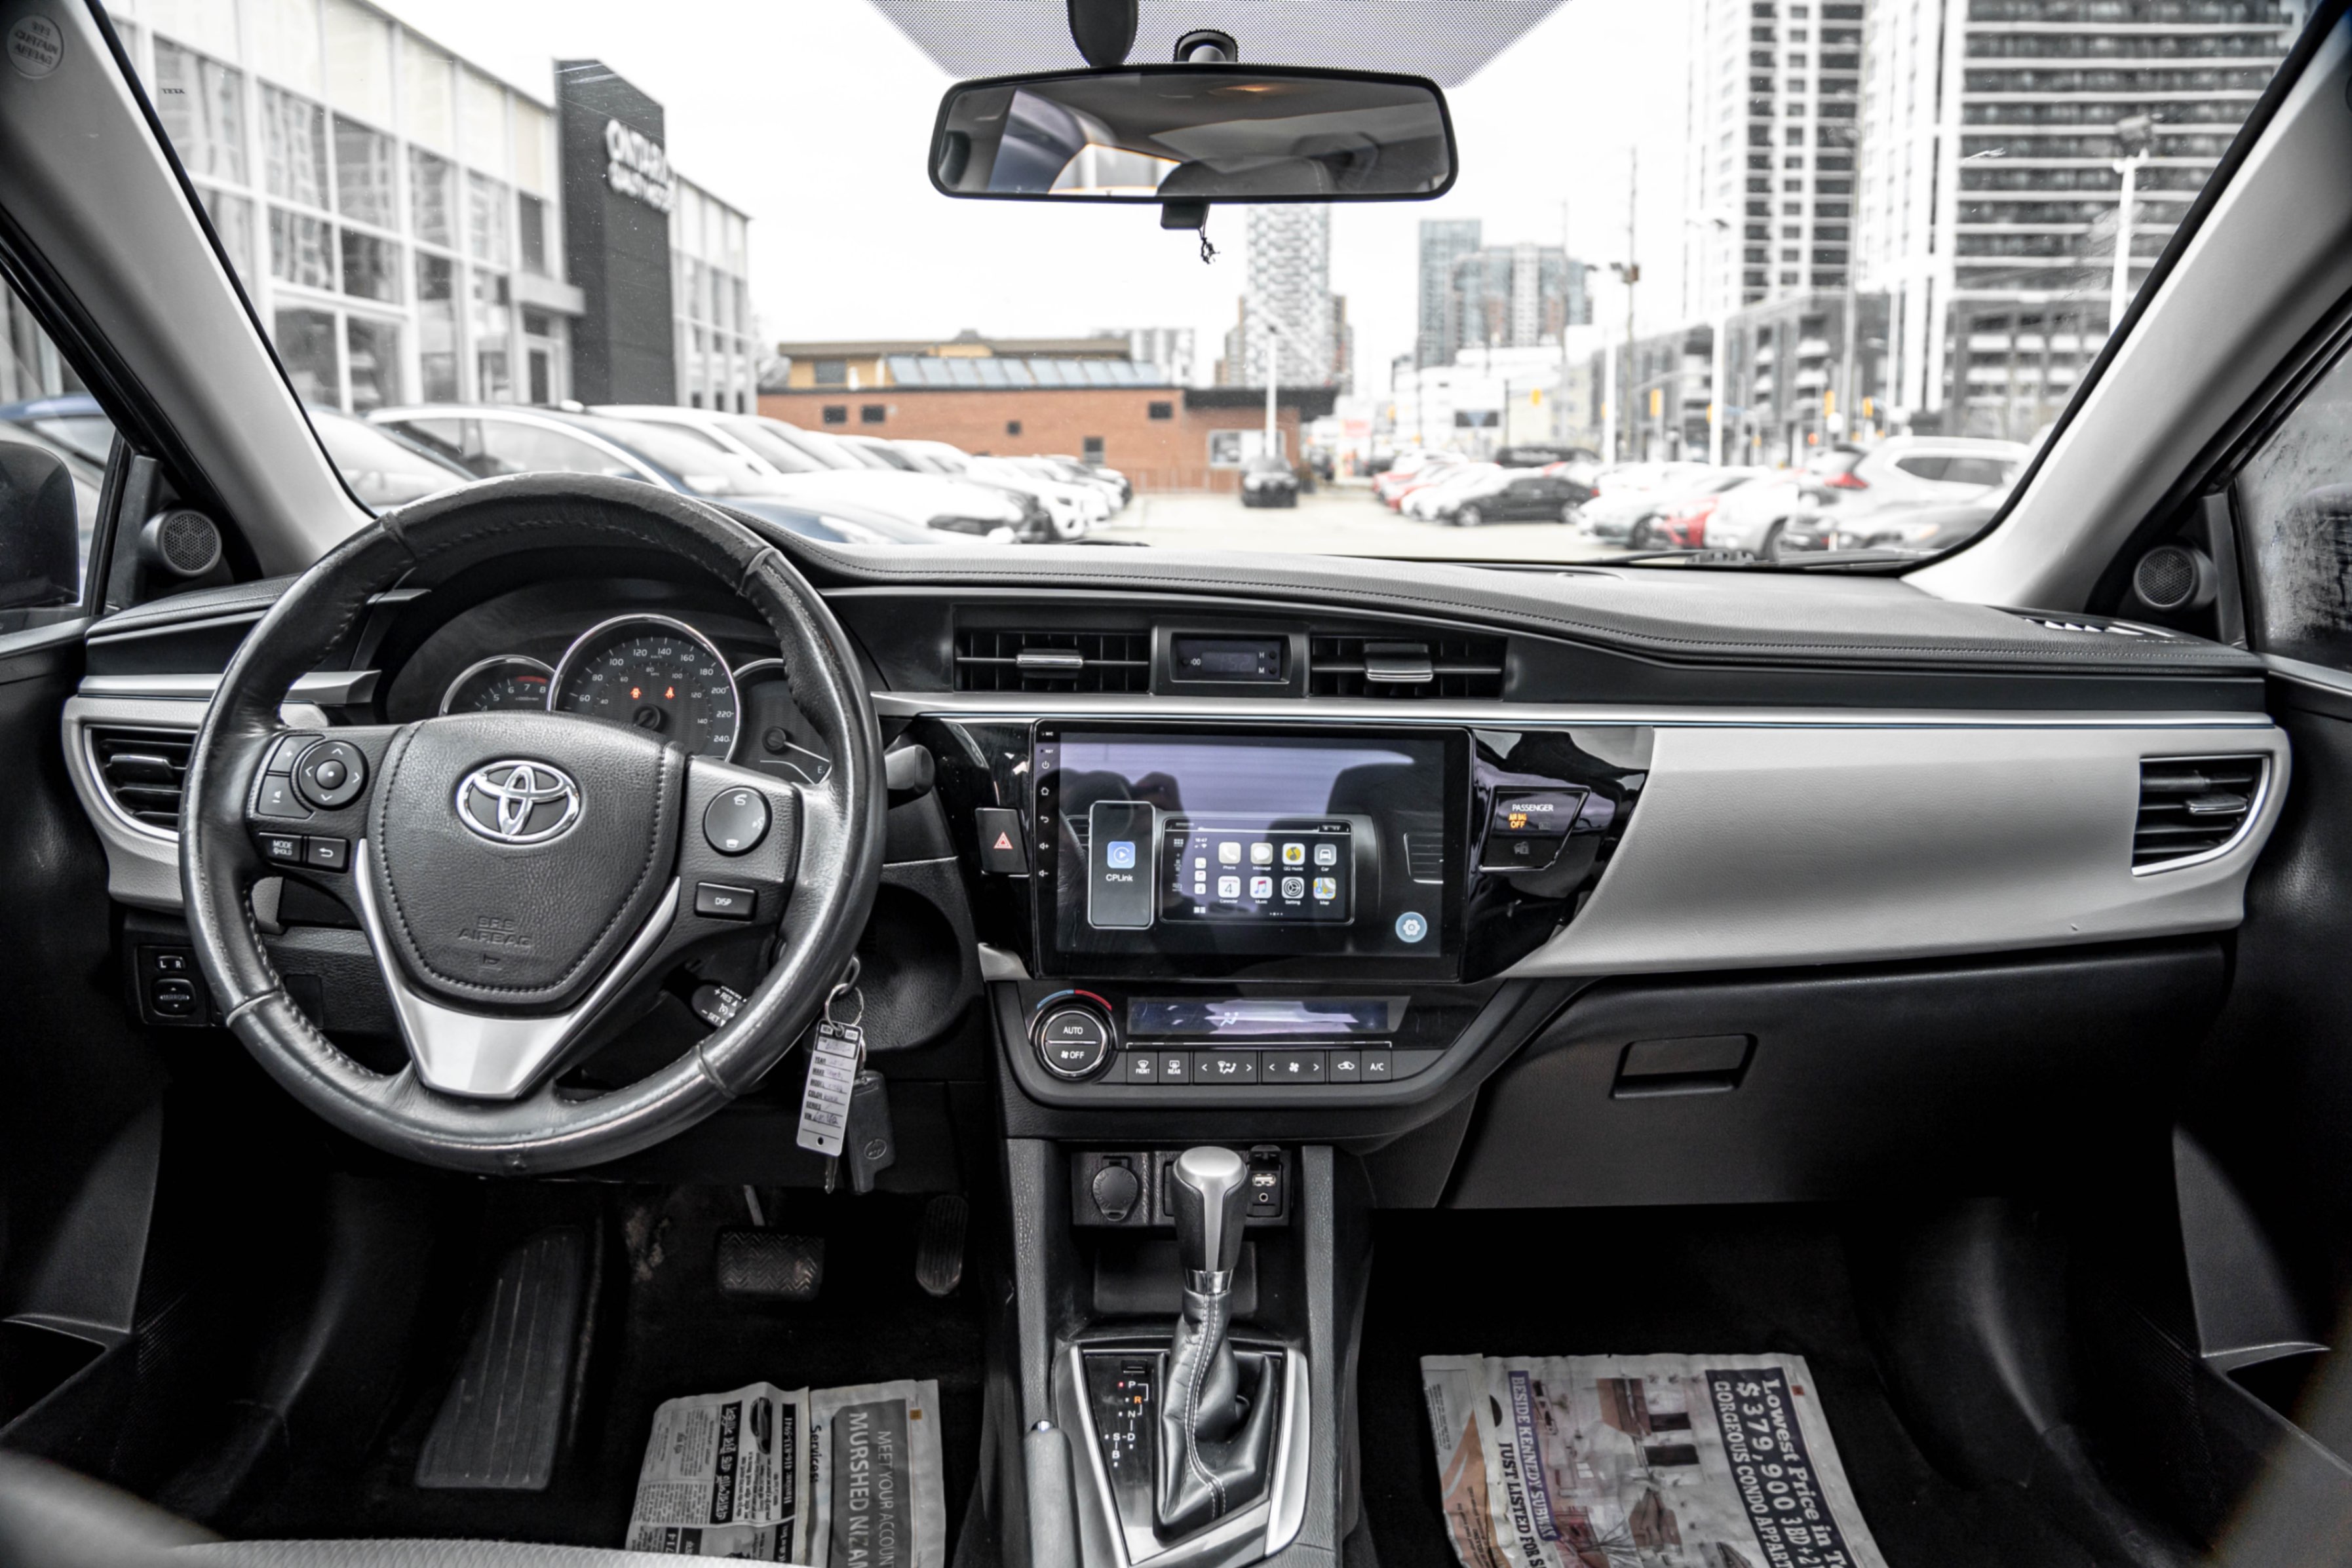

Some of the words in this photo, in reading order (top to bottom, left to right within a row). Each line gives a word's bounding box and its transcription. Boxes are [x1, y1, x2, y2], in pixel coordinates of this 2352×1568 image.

[817, 765, 823, 774] E
[1510, 820, 1526, 829] OFF
[273, 840, 292, 849] MODE
[1106, 873, 1133, 882] CPLink
[1224, 883, 1233, 894] 4
[715, 897, 732, 906] DISP
[478, 916, 515, 930] SRS
[458, 928, 532, 948] AIRBAG
[720, 991, 733, 1003] RES
[708, 1012, 720, 1023] SET
[1063, 1026, 1083, 1035] AUTO
[1370, 1062, 1384, 1071] A/C
[807, 1089, 822, 1100] COLOR
[1511, 1376, 1530, 1423] BESIDE
[1113, 1432, 1121, 1441] S
[1127, 1432, 1135, 1442] D
[877, 1430, 893, 1468] MEET
[1714, 1381, 1751, 1463] GORGEOUS
[1737, 1465, 1769, 1514] CONDO
[1111, 1449, 1120, 1459] B
[1518, 1426, 1541, 1487] KENNEDY
[849, 1412, 869, 1511] MURSHED
[1498, 1442, 1517, 1480] JUST
[1762, 1378, 1800, 1462] Lowest
[1788, 1466, 1821, 1521] Price
[1811, 1525, 1832, 1547] in
[878, 1471, 894, 1510] YOUR
[1507, 1482, 1531, 1534] LISTED
[1531, 1489, 1557, 1538] SUBWAY
[1519, 1536, 1540, 1558] FOR
